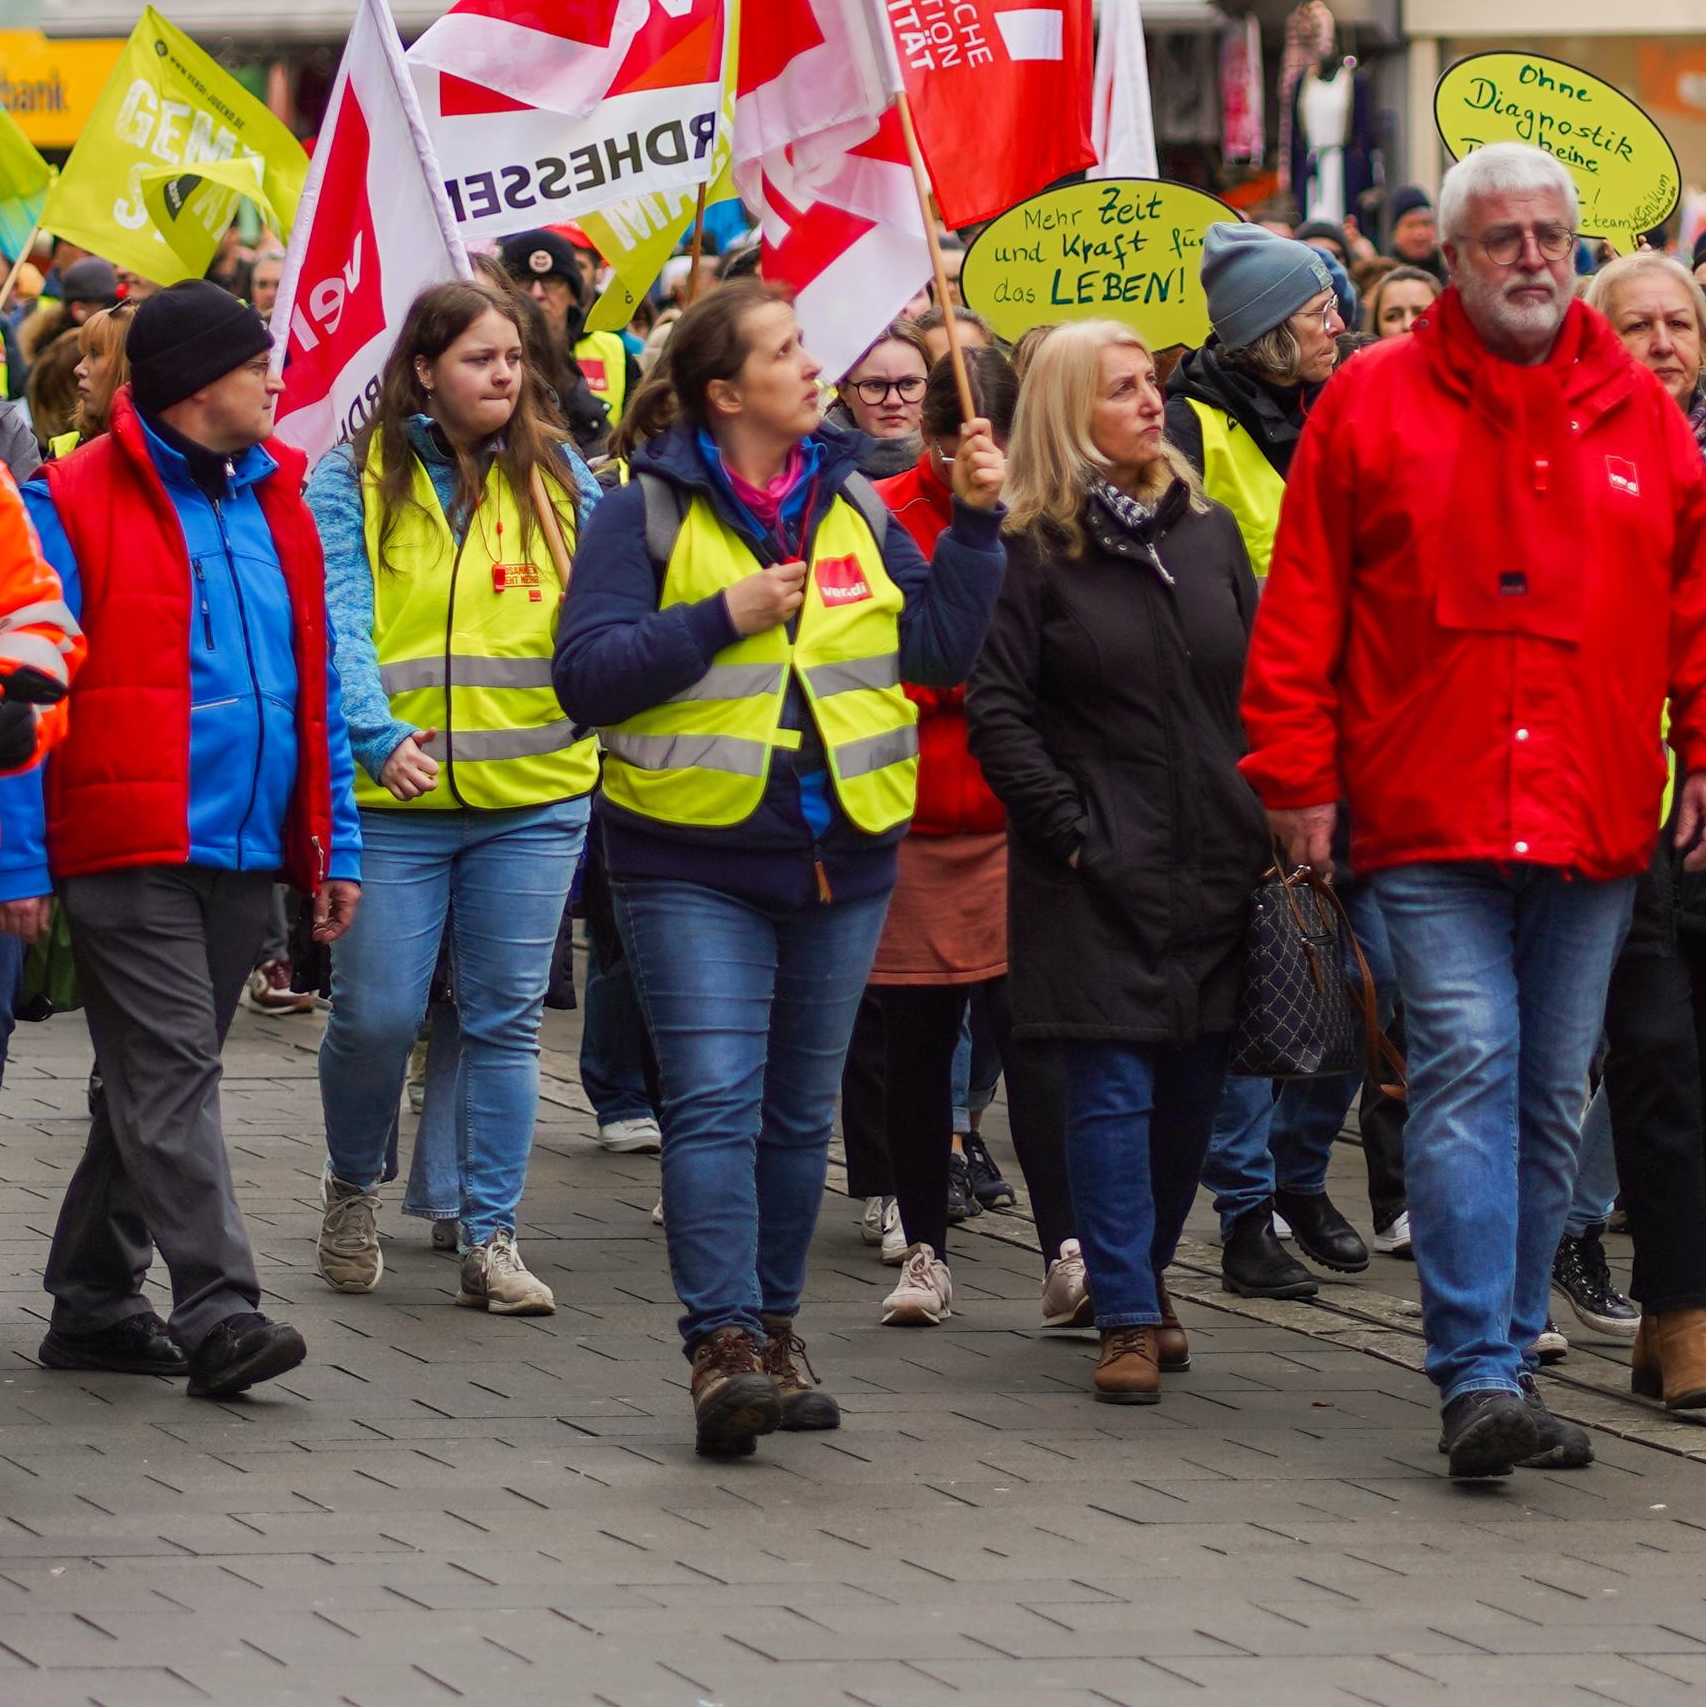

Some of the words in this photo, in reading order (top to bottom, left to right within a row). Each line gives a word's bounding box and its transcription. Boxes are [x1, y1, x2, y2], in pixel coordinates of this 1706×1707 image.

[1519, 63, 1593, 103] Ohne
[1463, 77, 1635, 163] Diagnostik
[1024, 209, 1083, 232] Mehr
[1098, 187, 1163, 225] Zeit
[995, 241, 1046, 263] und
[1062, 230, 1148, 271] Kraft
[994, 278, 1036, 304] das
[1050, 267, 1185, 306] LEBEN!
[821, 582, 868, 598] ver.di
